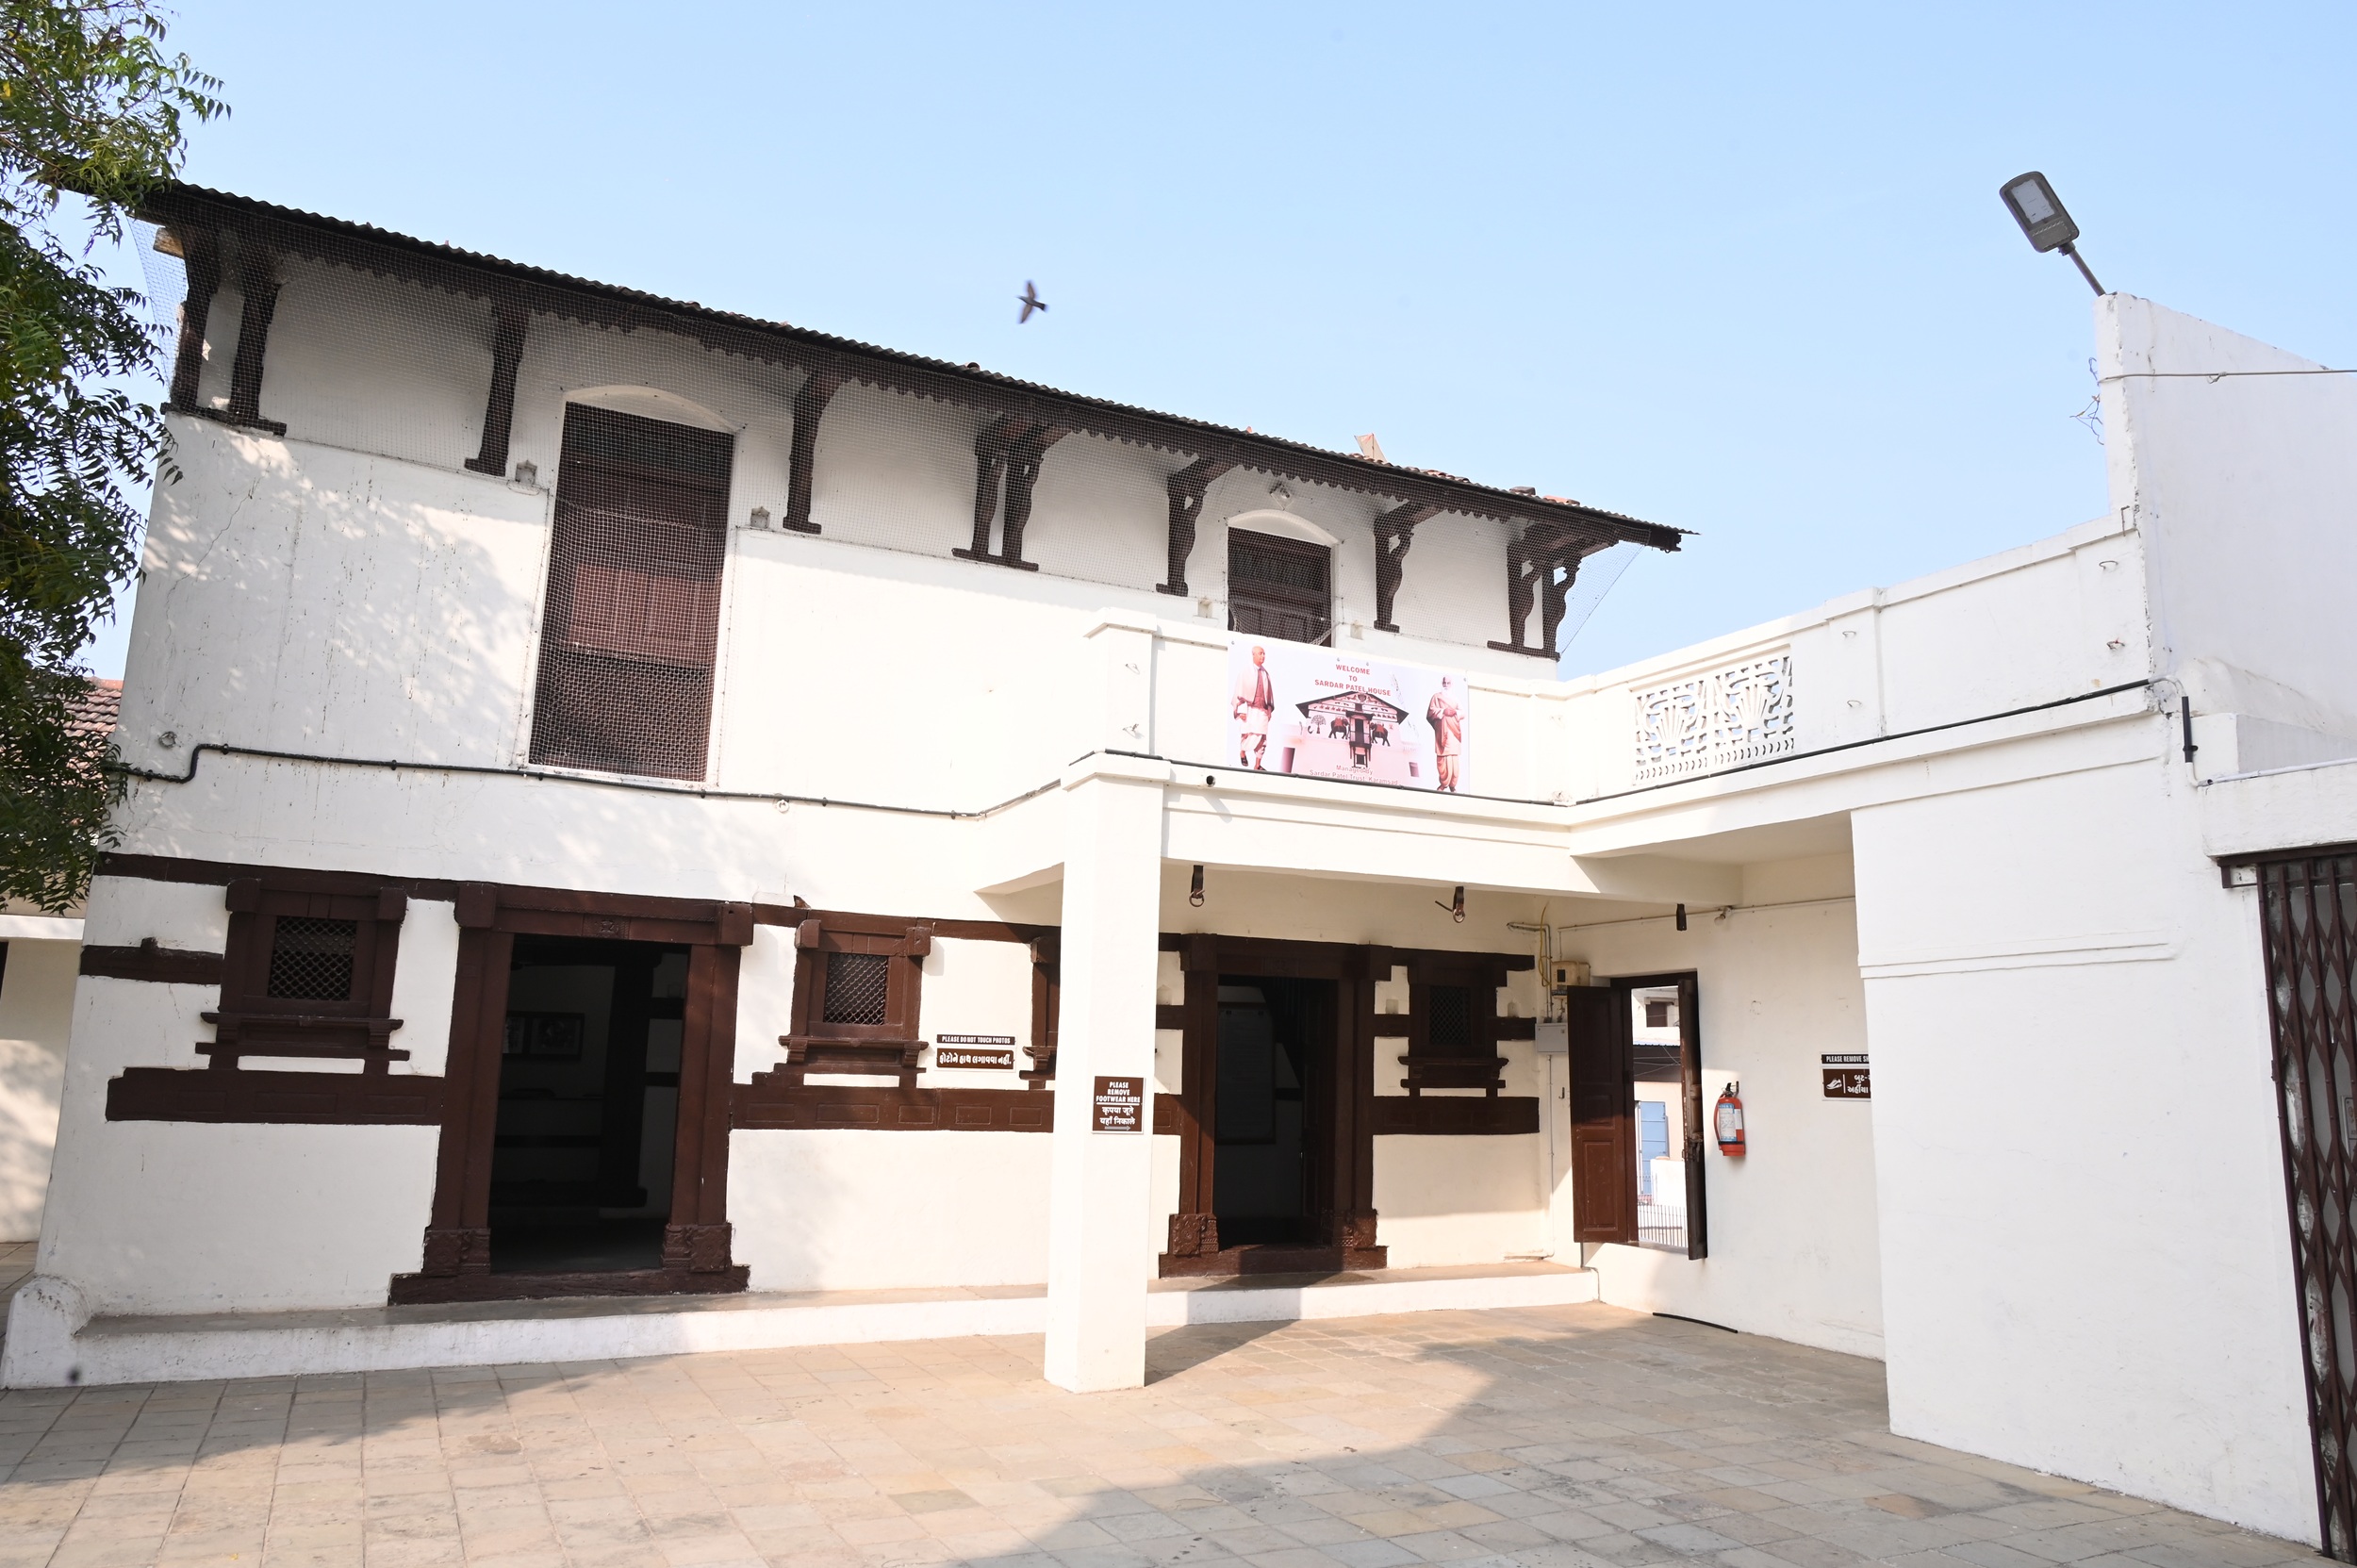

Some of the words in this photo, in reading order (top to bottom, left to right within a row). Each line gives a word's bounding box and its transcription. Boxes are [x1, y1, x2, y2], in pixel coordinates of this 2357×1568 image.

[1336, 664, 1370, 675] WELCOME
[1314, 679, 1343, 689] SARDAR
[1345, 684, 1366, 692] PATEL
[1367, 687, 1392, 696] HOUSE
[1368, 777, 1398, 785] Karamsad
[1109, 1081, 1129, 1089] PLEASE
[1101, 1106, 1122, 1115] कृपया
